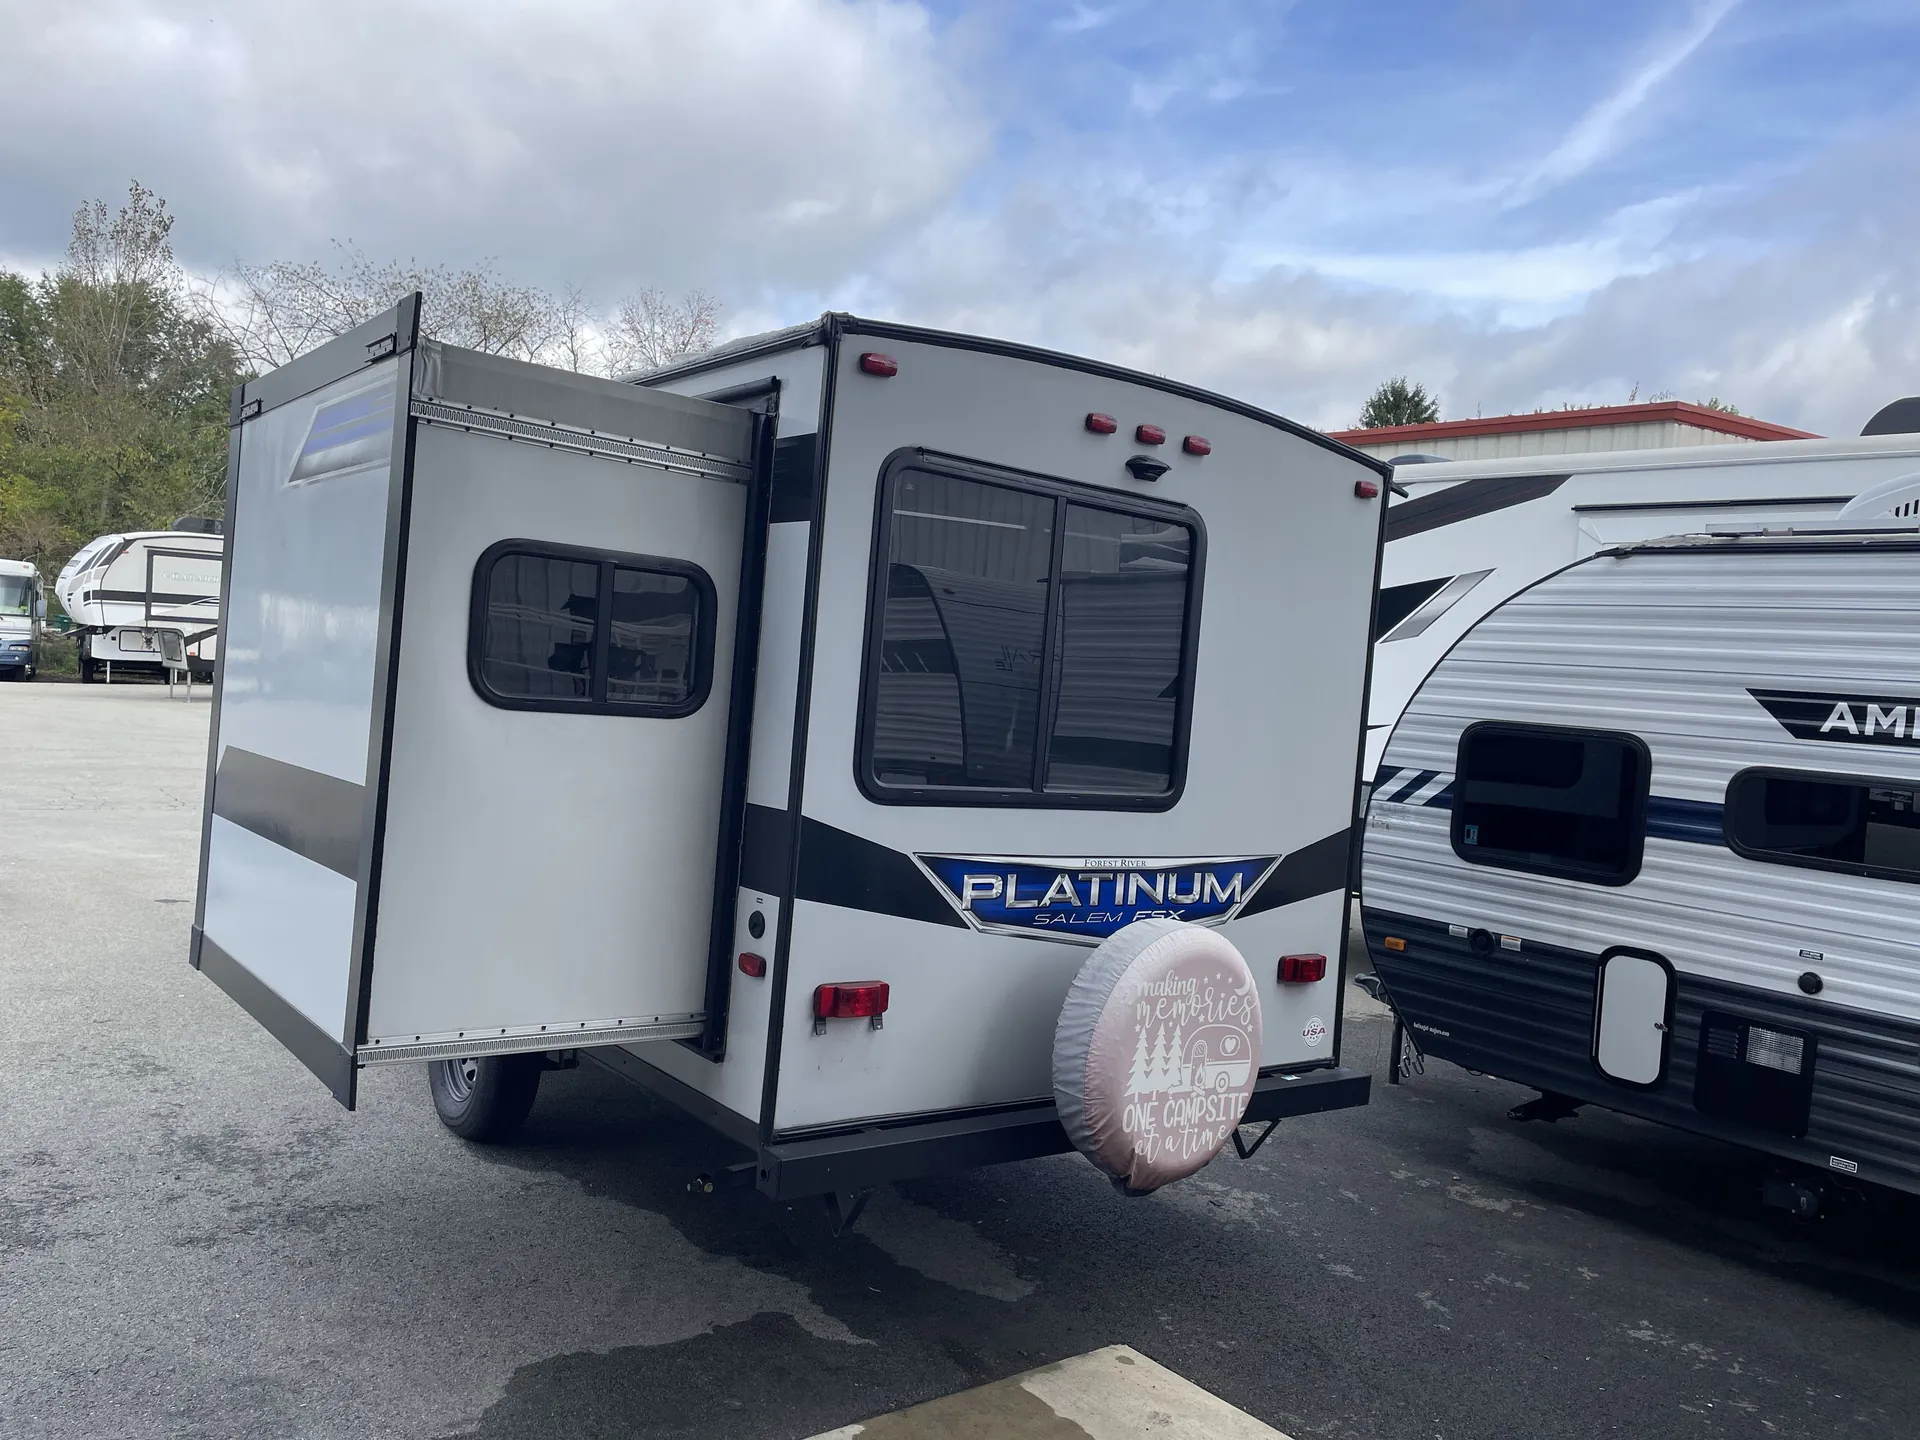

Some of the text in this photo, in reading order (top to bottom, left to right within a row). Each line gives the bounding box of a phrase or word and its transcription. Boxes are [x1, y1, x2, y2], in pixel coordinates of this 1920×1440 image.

[1084, 859, 1147, 867] FOREST RIVER
[962, 873, 1243, 910] PLATINUM
[1033, 911, 1123, 925] SALEM
[1136, 969, 1199, 1005] making
[1136, 987, 1257, 1028] memories
[1302, 1027, 1326, 1037] USA
[1122, 1092, 1248, 1133] ONE CAMPSITE
[1135, 1123, 1231, 1164] at a time
